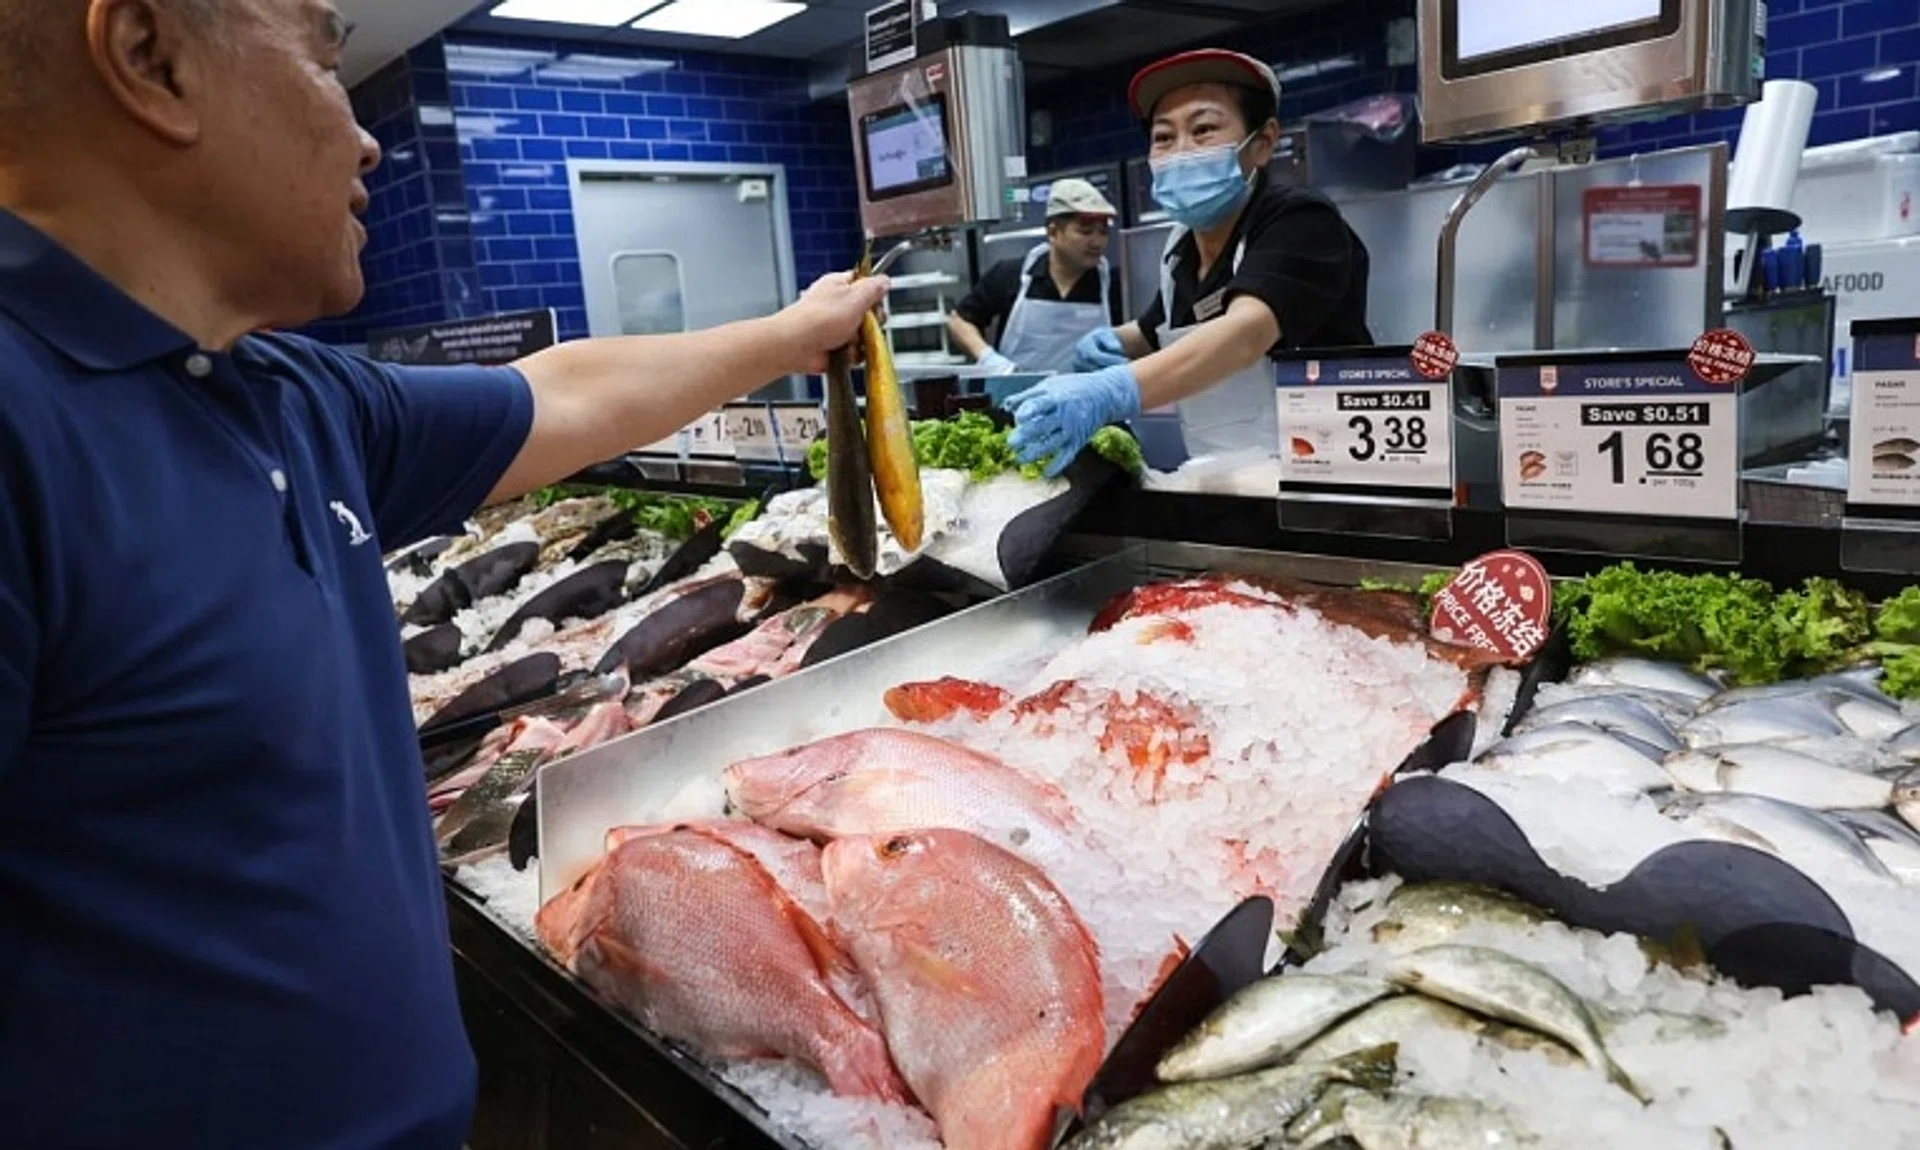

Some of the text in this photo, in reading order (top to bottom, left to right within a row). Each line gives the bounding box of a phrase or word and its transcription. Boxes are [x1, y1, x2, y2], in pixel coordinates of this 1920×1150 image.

[1343, 394, 1425, 407] Save $0.41
[1584, 376, 1684, 389] STORE'S SPECIAL
[1588, 405, 1700, 422] Save $0.51
[1348, 415, 1428, 461] 3.38
[1598, 430, 1705, 484] 1.68
[1434, 588, 1473, 628] PRICE
[1454, 560, 1545, 657] 价格冻结
